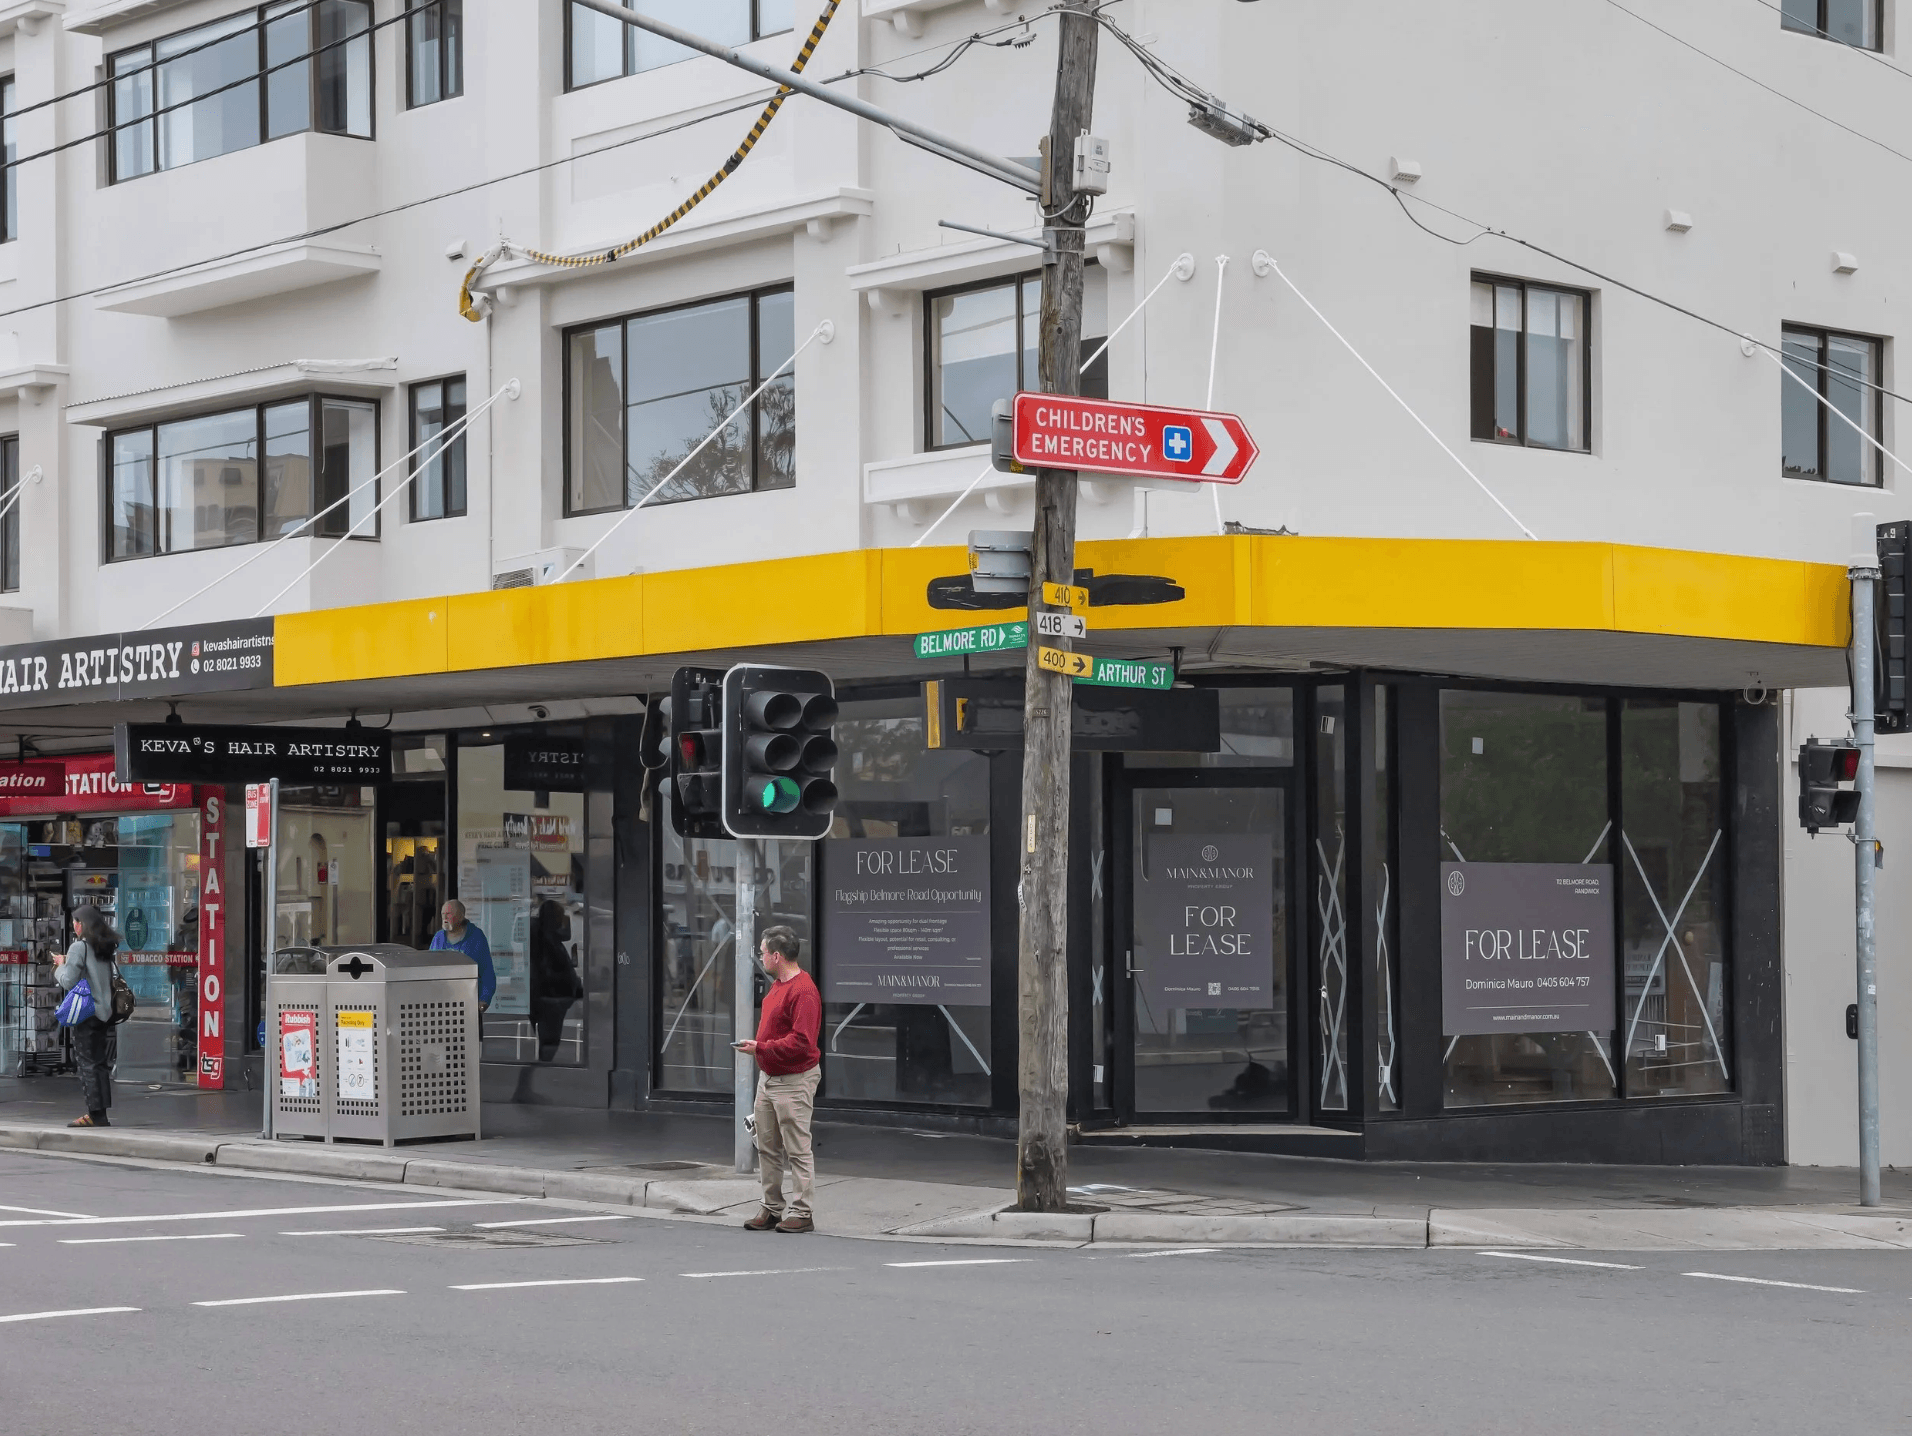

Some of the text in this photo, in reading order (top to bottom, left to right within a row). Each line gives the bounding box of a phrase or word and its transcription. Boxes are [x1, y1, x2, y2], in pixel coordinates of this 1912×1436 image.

[1036, 407, 1145, 437] CHILDREN'S
[1032, 433, 1151, 463] EMERGENCY
[1054, 586, 1070, 604] 410
[1039, 615, 1062, 634] 418
[921, 631, 976, 654] BELMORE
[980, 628, 997, 647] RD
[0, 641, 183, 694] AIR ARTISTRY
[203, 655, 262, 673] 02 8021 9933
[1044, 651, 1066, 668] 400
[1097, 663, 1167, 686] ARTHUR ST
[140, 737, 380, 758] KEVA'S HAIR ARTISTRY
[331, 766, 352, 774] 8021
[247, 790, 257, 799] BUS
[857, 849, 958, 875] FOR LEASE
[1166, 867, 1254, 879] MAIN&MANOR
[1563, 878, 1585, 886] BELMORE
[835, 888, 982, 905] Flagship Belmore Road Opportunity
[1185, 905, 1236, 927] FOR
[1170, 934, 1251, 956] LEASE
[1465, 929, 1590, 960] FOR LEASE
[132, 954, 163, 963] TOBACCO
[164, 954, 193, 964] STATION
[878, 974, 940, 988] MAIN&MANOR
[1466, 976, 1590, 990] Dominica Mauro 0405 604 757
[285, 1013, 311, 1024] Rubbish
